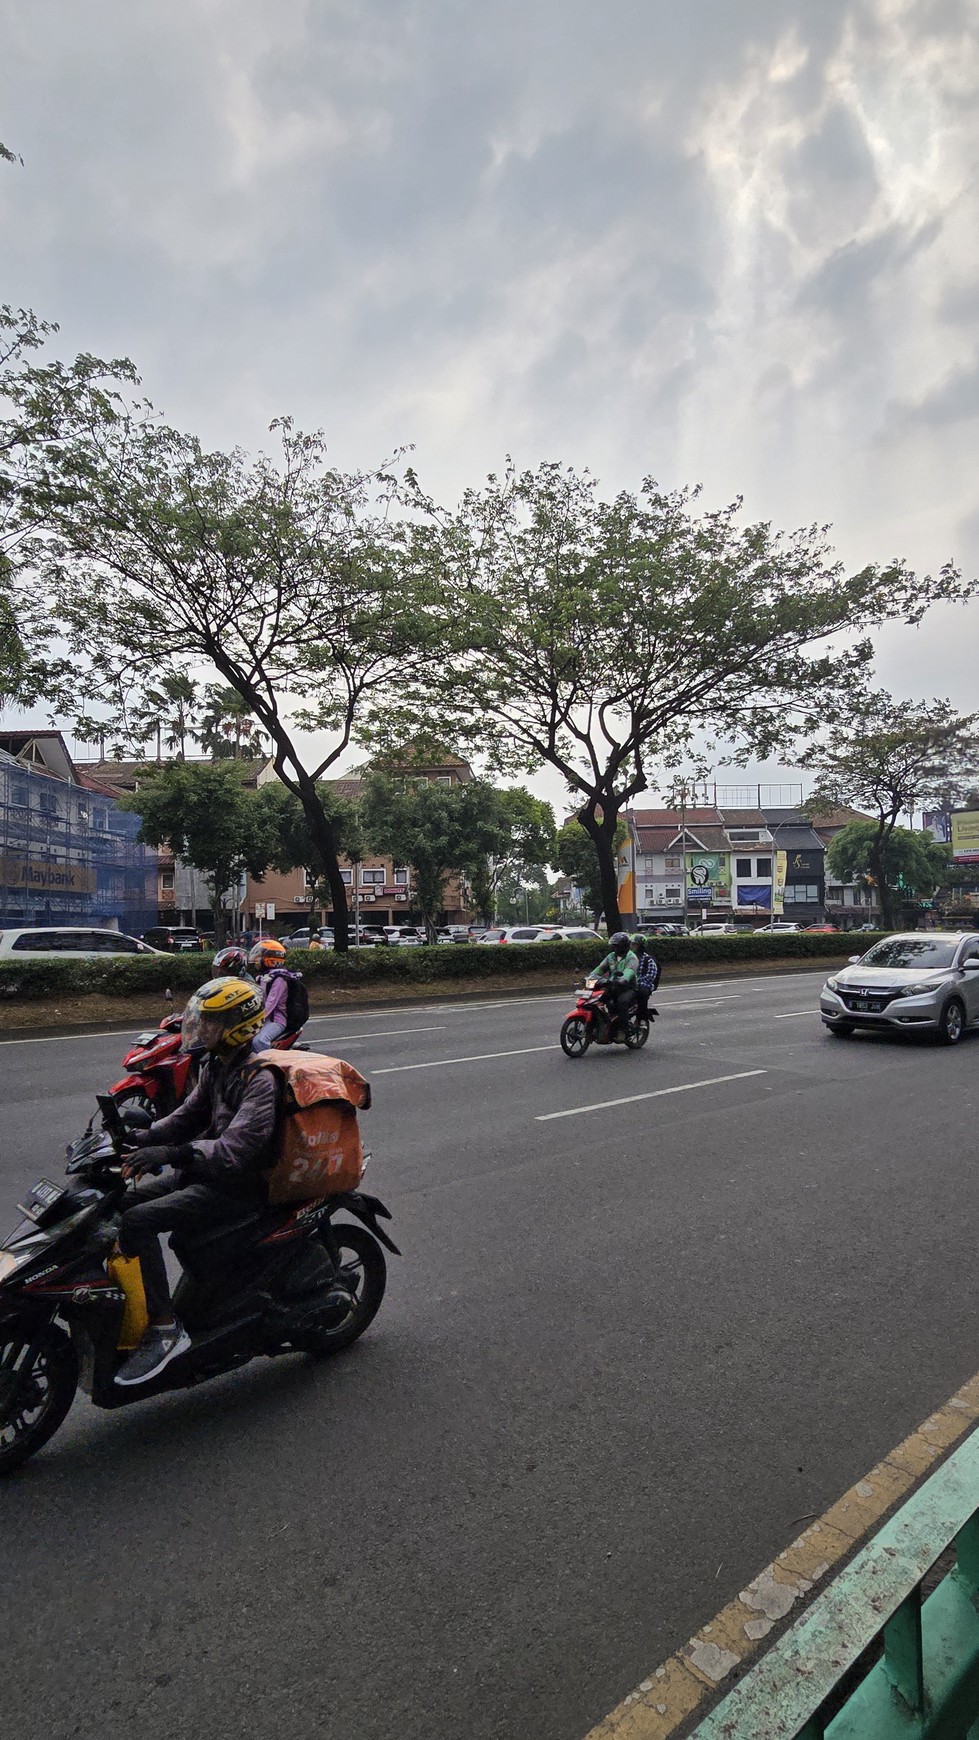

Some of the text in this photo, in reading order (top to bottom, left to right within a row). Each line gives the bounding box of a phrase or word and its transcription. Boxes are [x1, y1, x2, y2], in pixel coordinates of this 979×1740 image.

[21, 865, 75, 887] Maybank
[688, 888, 711, 896] Smiling
[24, 1264, 59, 1284] HONDA
